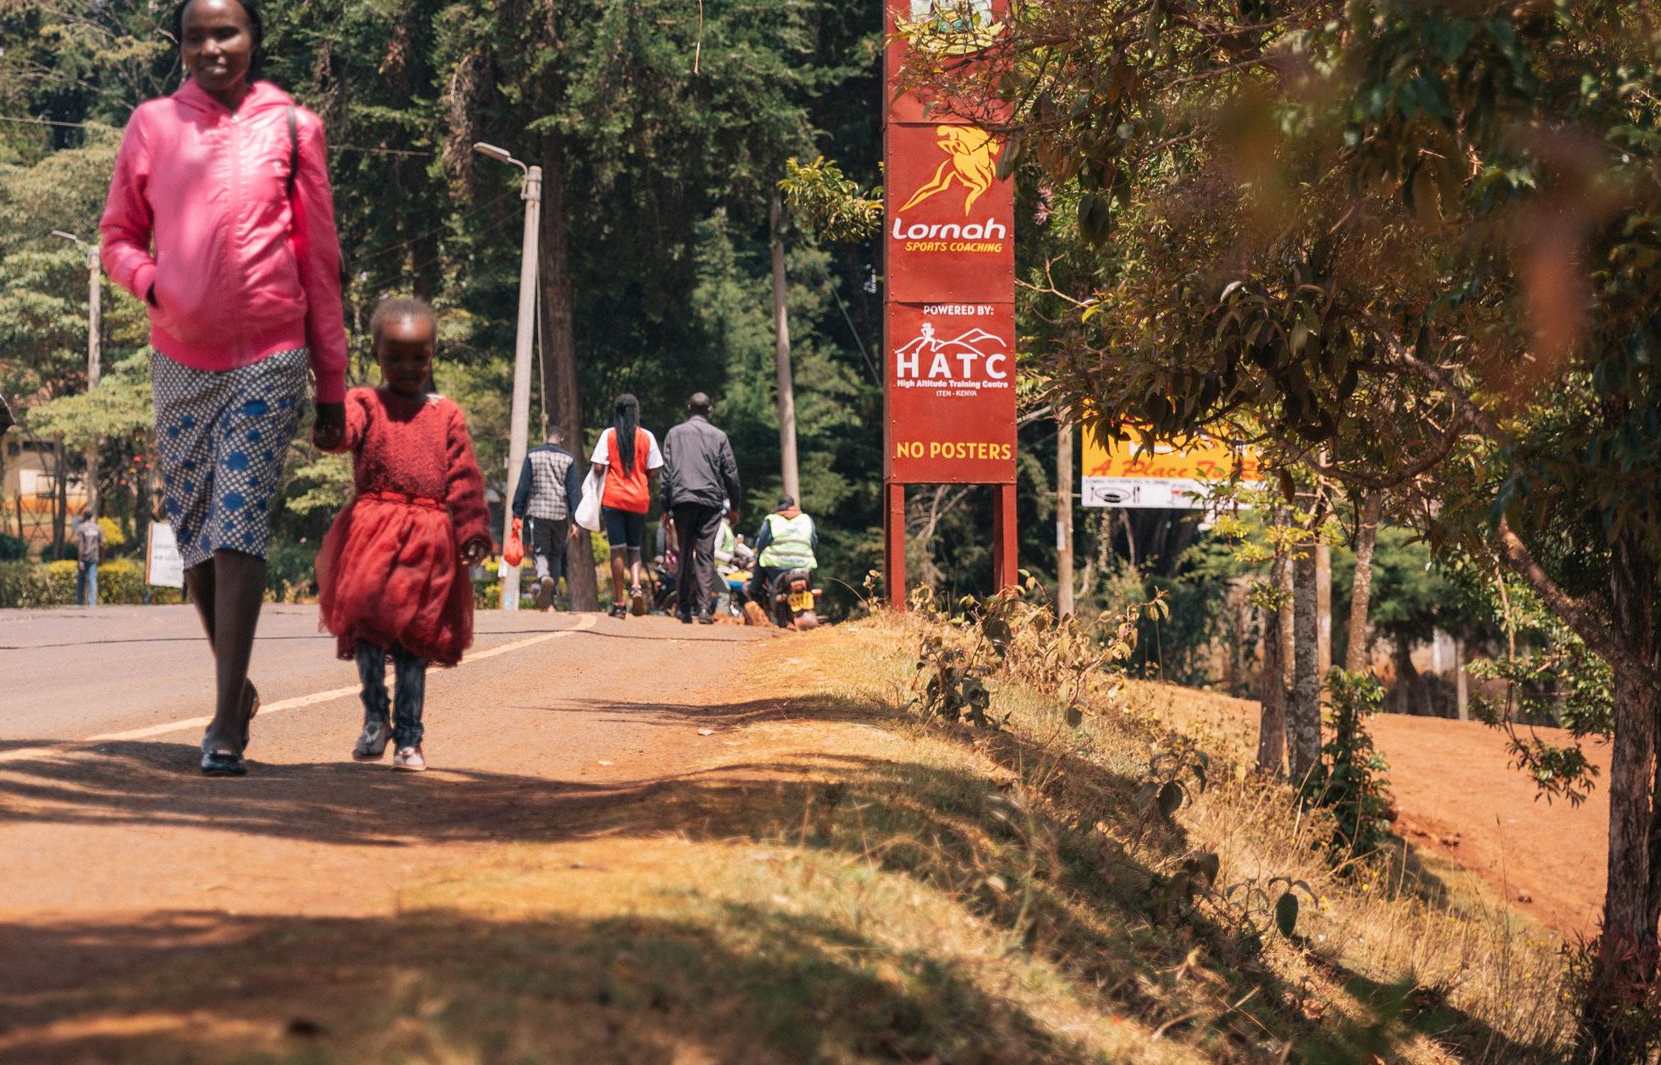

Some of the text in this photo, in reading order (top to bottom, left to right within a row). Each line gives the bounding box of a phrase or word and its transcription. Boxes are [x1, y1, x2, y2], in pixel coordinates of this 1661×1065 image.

[892, 217, 1006, 240] Lornah
[904, 241, 1003, 253] SPORTS COACHING
[923, 305, 994, 316] POWERED BY:
[896, 353, 1007, 379] HATC
[896, 379, 1009, 390] High Altitude Training Centre
[896, 441, 1012, 460] NO POSTERS
[1121, 459, 1189, 478] Place
